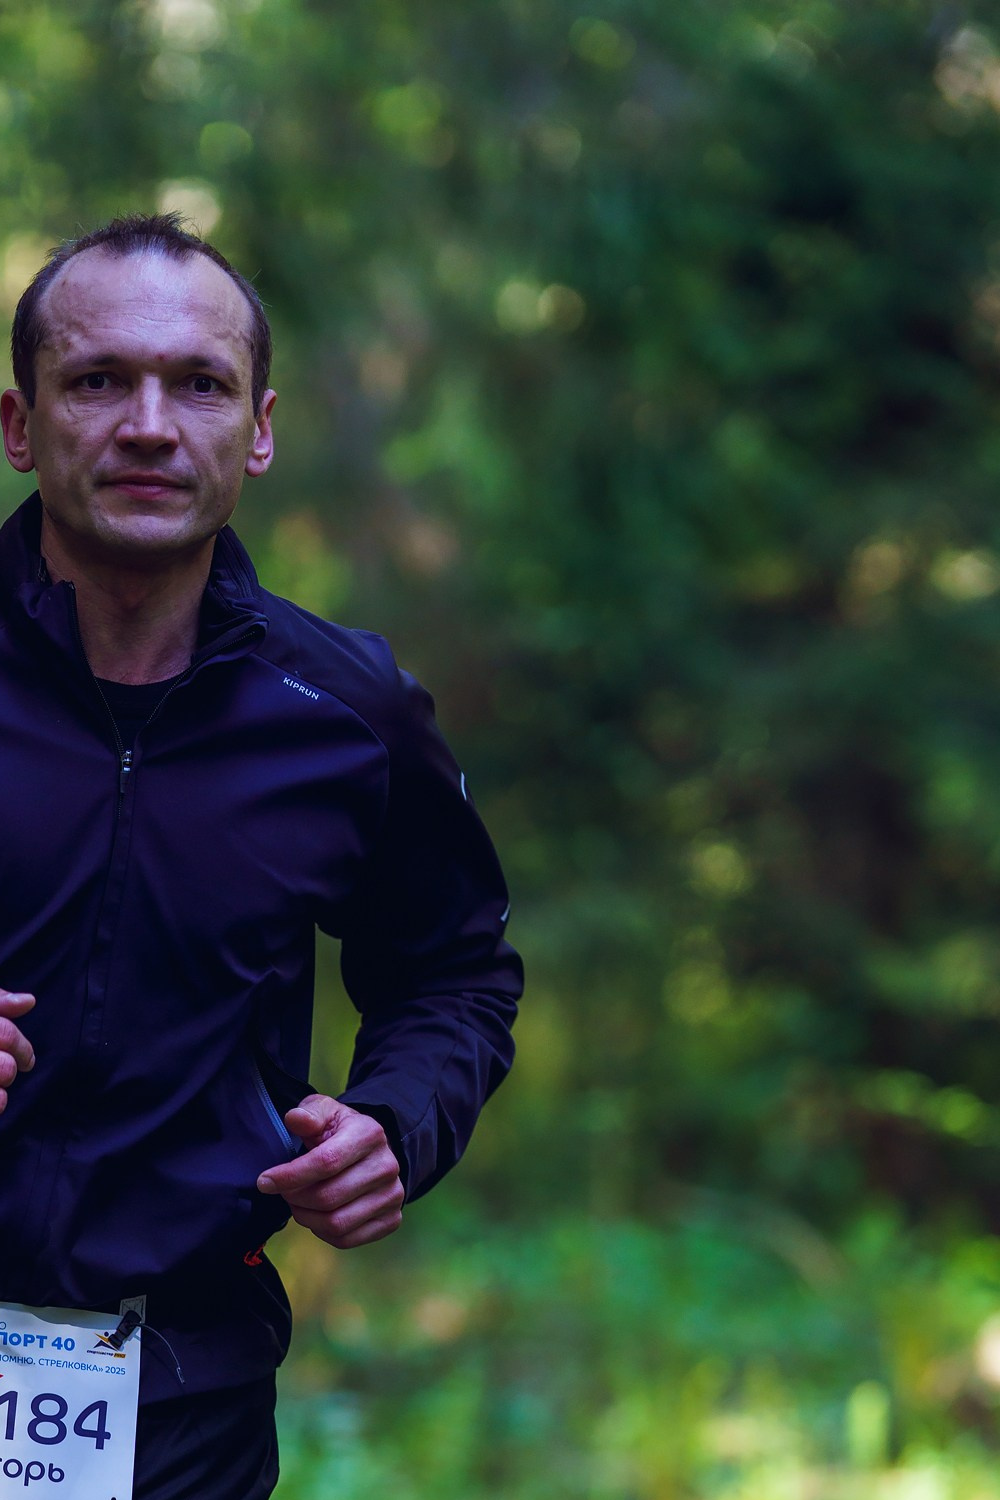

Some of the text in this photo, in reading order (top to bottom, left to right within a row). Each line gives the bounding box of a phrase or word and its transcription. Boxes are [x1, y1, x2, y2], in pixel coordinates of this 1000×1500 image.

[283, 677, 320, 700] KIPRUN
[51, 1336, 76, 1351] 40
[38, 1358, 104, 1373] СТРЕЛКОВКА»
[105, 1366, 126, 1376] 2025
